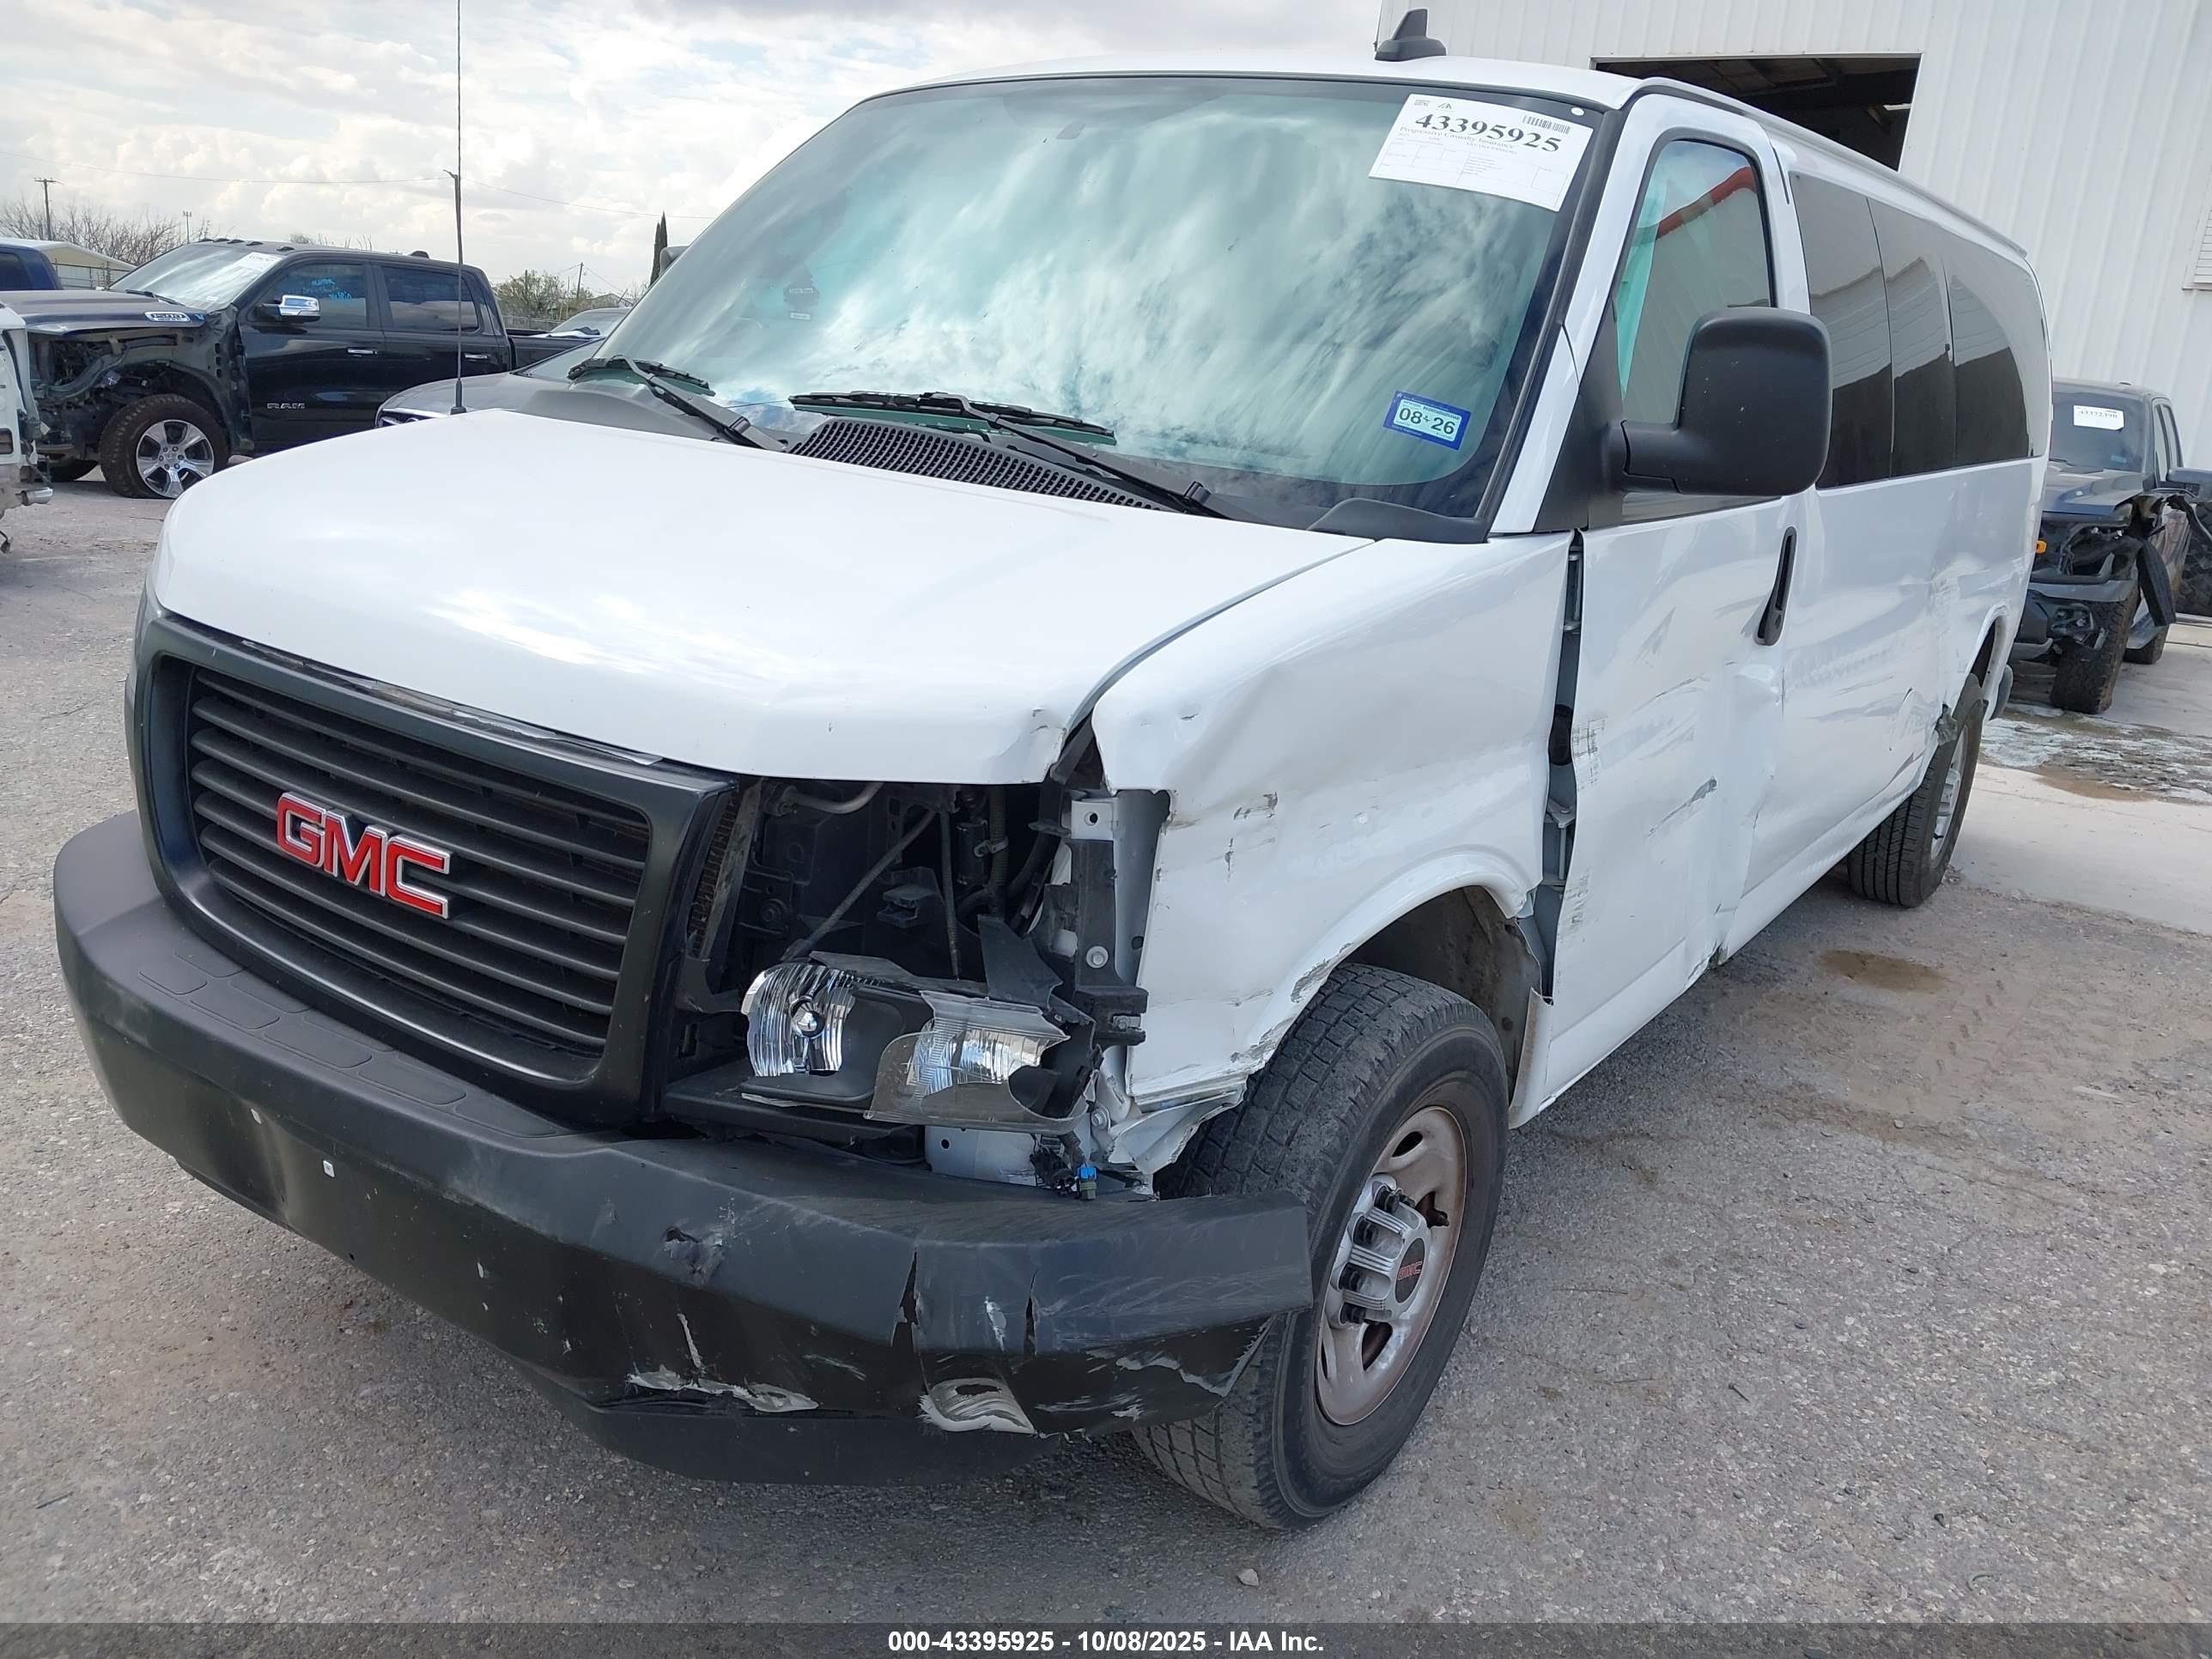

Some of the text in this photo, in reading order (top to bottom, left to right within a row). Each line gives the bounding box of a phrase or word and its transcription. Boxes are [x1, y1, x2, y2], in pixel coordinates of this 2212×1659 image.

[1415, 113, 1562, 152] 43395925
[1478, 137, 1515, 149] Insurance
[1399, 408, 1423, 423] 08
[1431, 417, 1455, 434] 26
[276, 792, 450, 919] GMC
